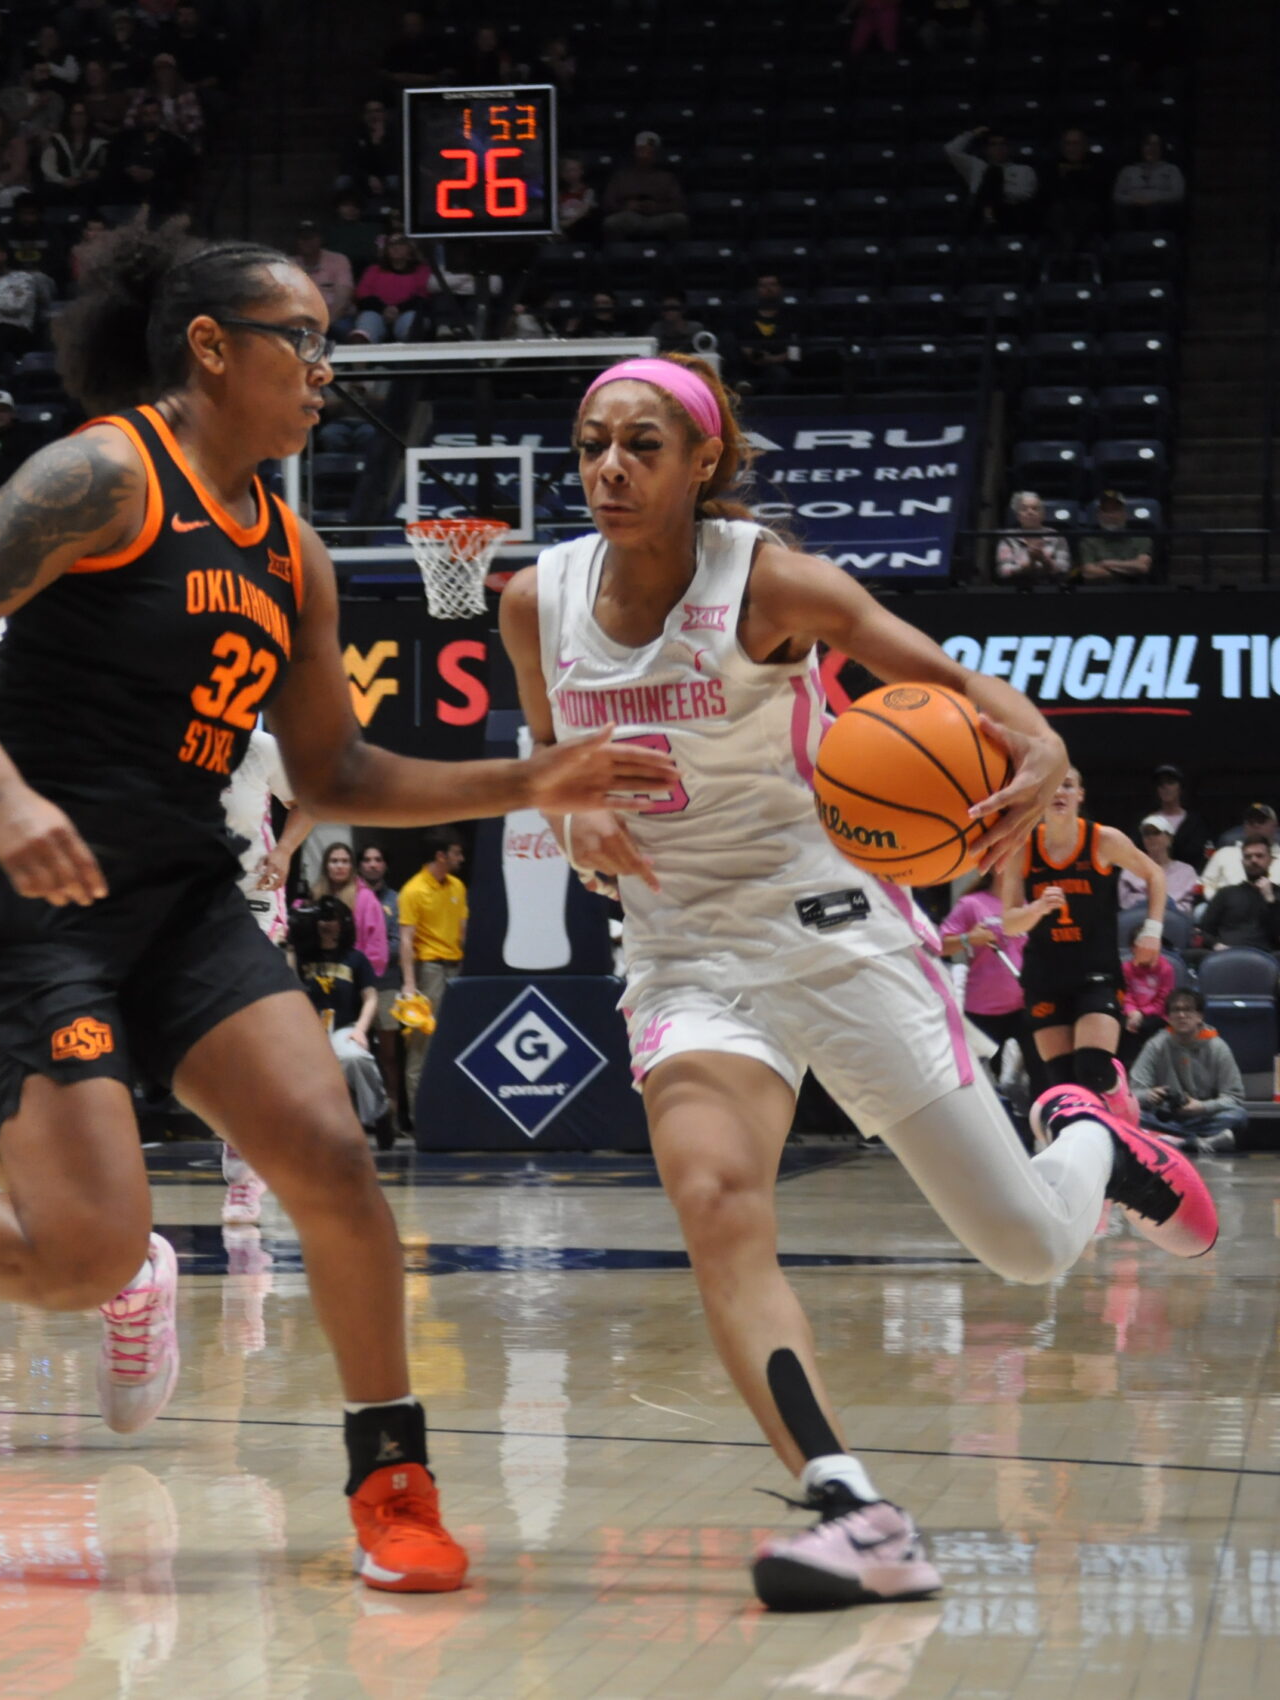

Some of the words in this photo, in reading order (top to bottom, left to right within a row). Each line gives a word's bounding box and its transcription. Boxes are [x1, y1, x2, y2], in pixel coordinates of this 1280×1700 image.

[436, 147, 528, 218] 26
[769, 467, 862, 484] JEEP
[874, 462, 958, 481] RAM
[190, 631, 279, 731] 32
[940, 634, 1201, 700] OFFICIAL
[1211, 635, 1280, 699] TI
[498, 1082, 566, 1098] gomart
